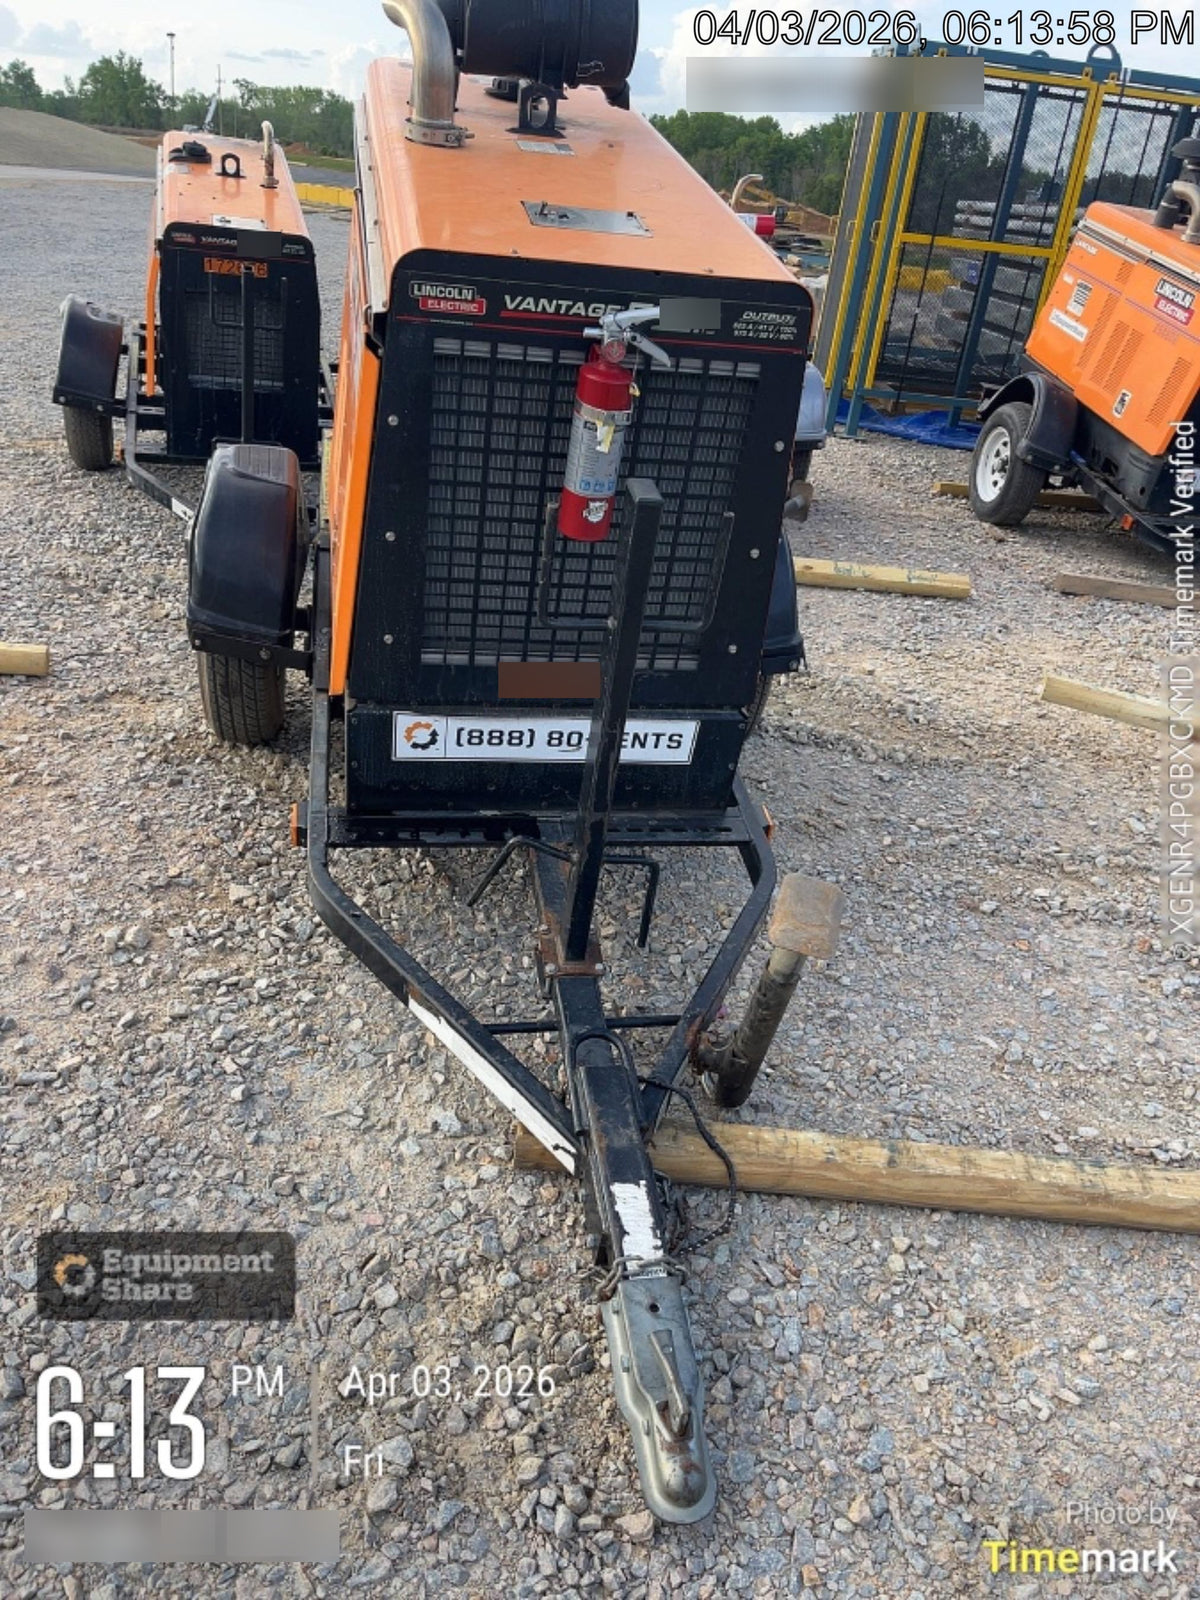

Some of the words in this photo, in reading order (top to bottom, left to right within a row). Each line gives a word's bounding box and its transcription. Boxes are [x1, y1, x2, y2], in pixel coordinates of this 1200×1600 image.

[413, 283, 473, 300] LINCOLN
[1156, 278, 1195, 308] LINCOLN
[427, 299, 480, 312] ELECTRIC
[504, 294, 622, 318] VANTAGE
[455, 727, 535, 748] (888)
[546, 729, 684, 751] 80ENTS
